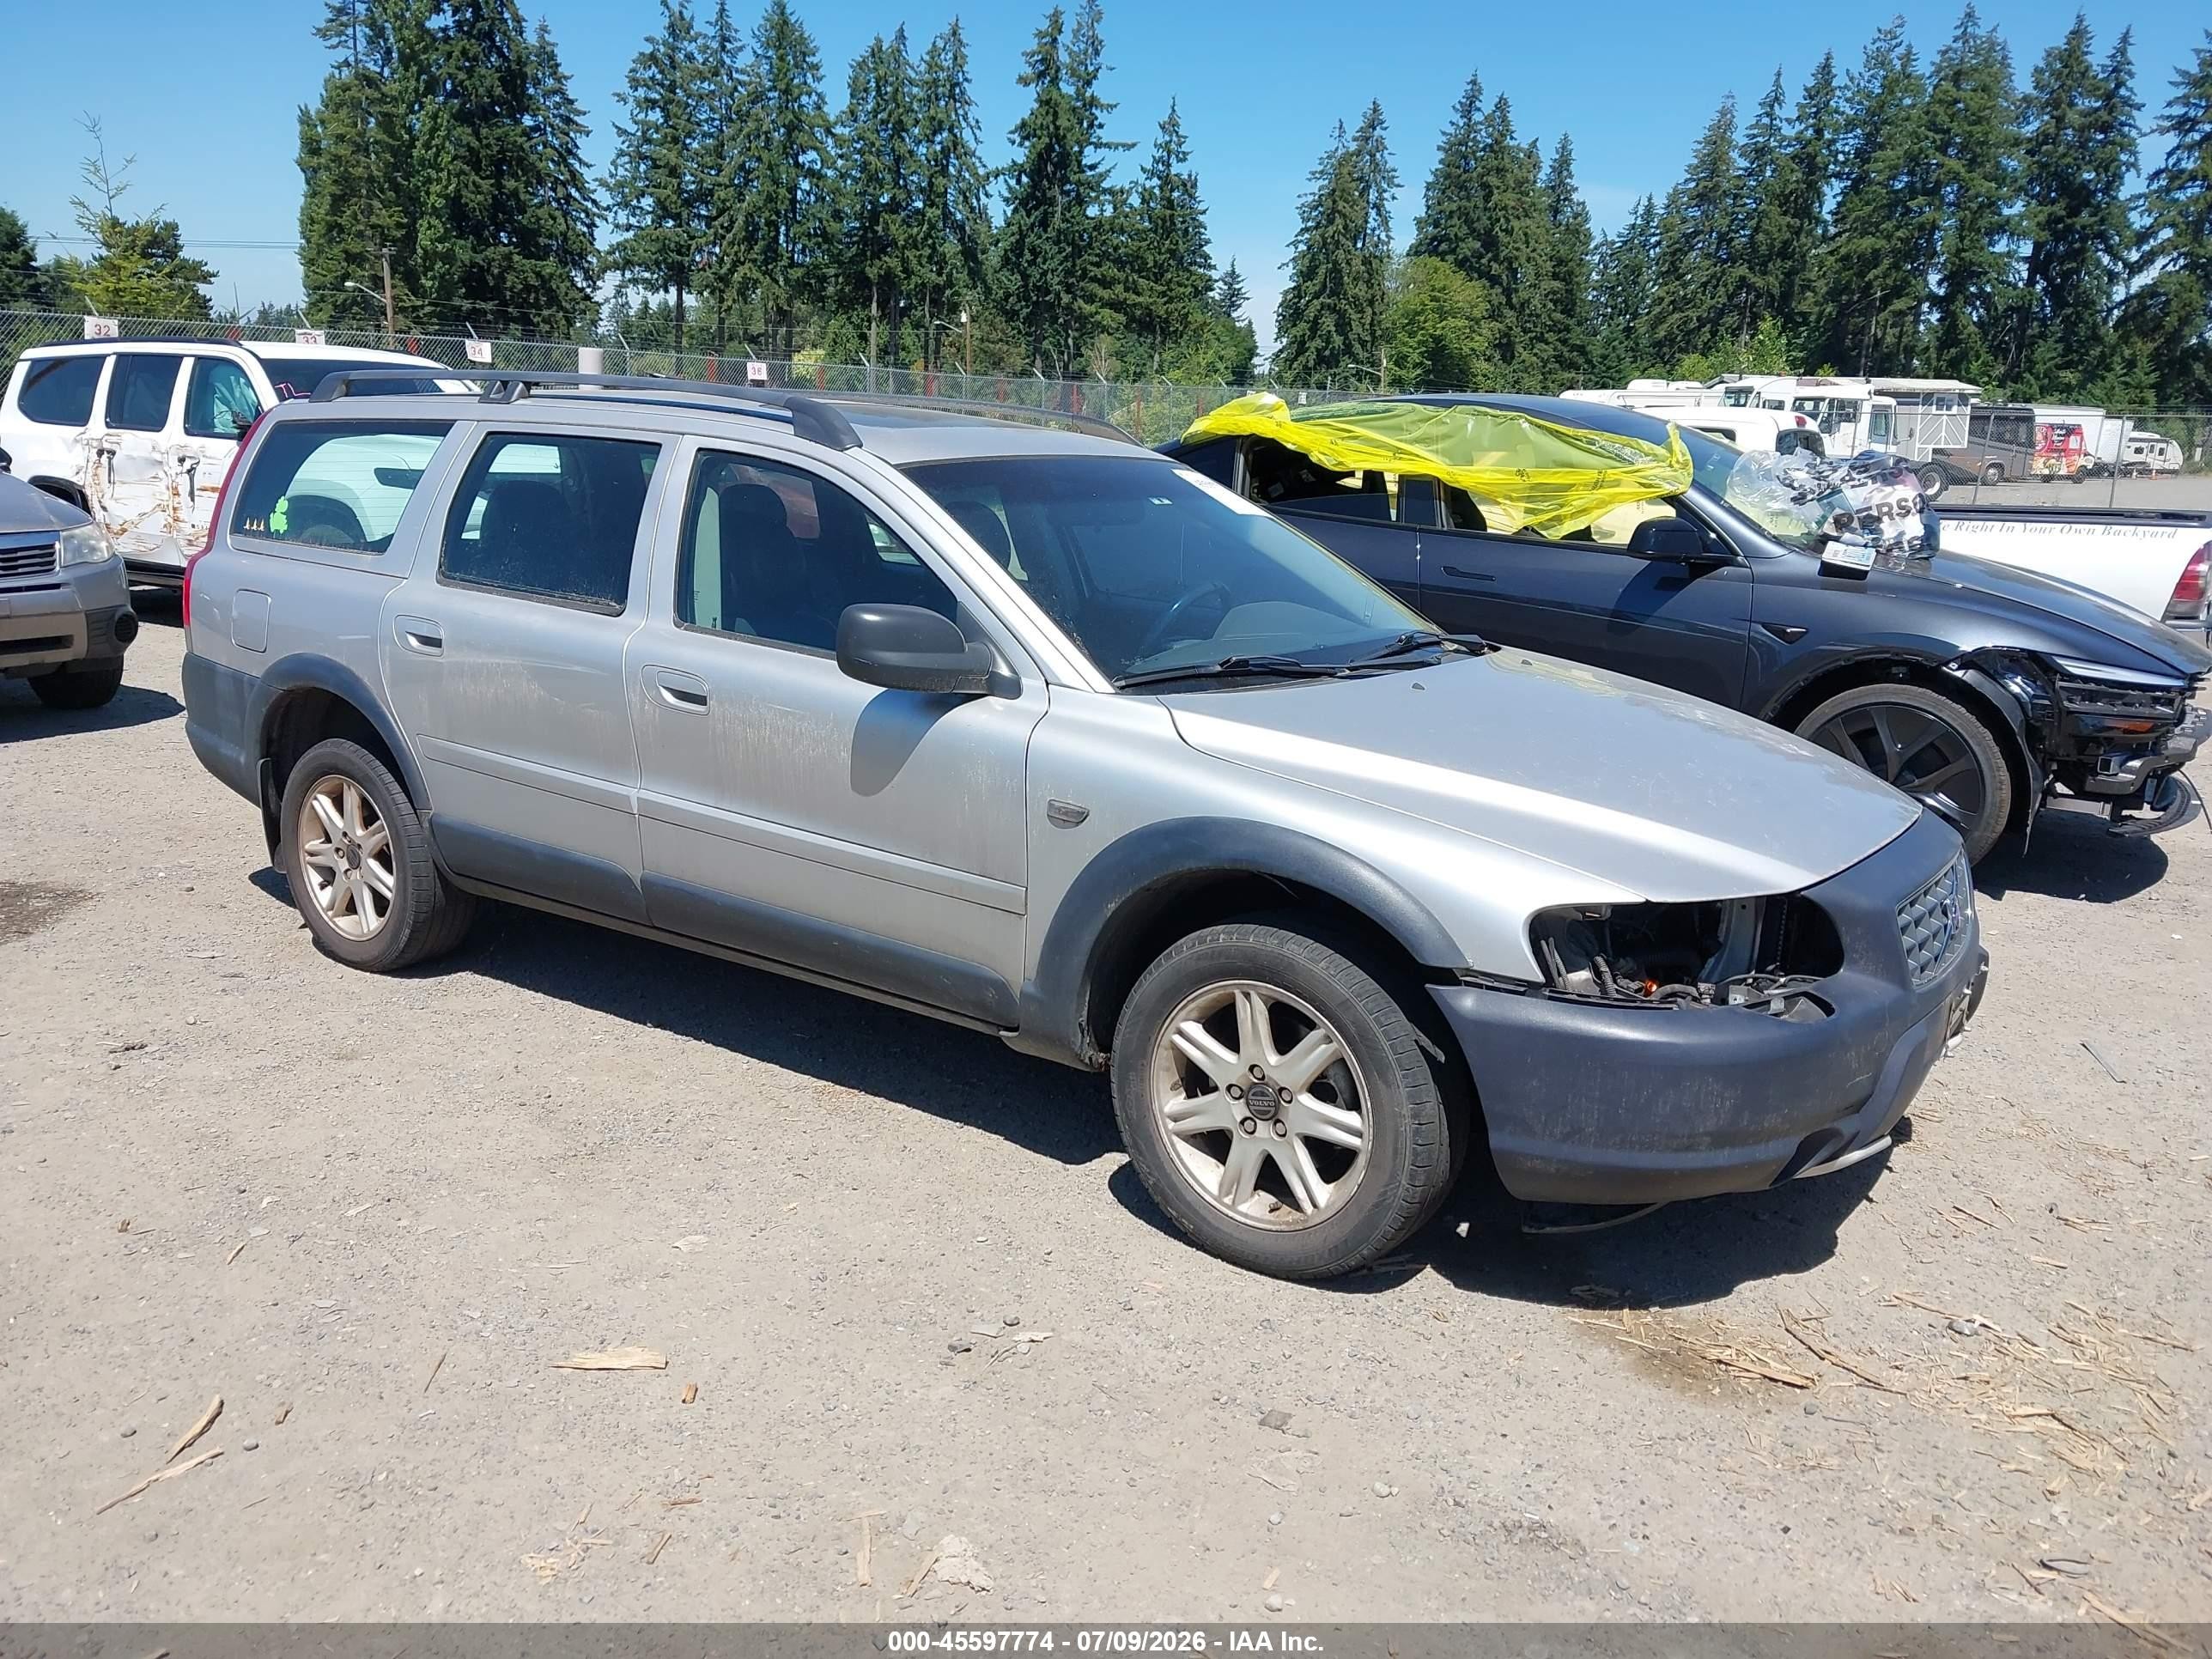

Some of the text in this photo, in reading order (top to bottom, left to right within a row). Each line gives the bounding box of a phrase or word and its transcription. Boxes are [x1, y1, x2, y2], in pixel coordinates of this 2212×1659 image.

[94, 323, 111, 337] 32
[471, 345, 483, 357] 34
[1954, 520, 1996, 533] Right
[1999, 522, 2015, 534] In
[2021, 523, 2056, 534] Your
[2060, 524, 2096, 536] Own
[2101, 525, 2178, 542] Backyard
